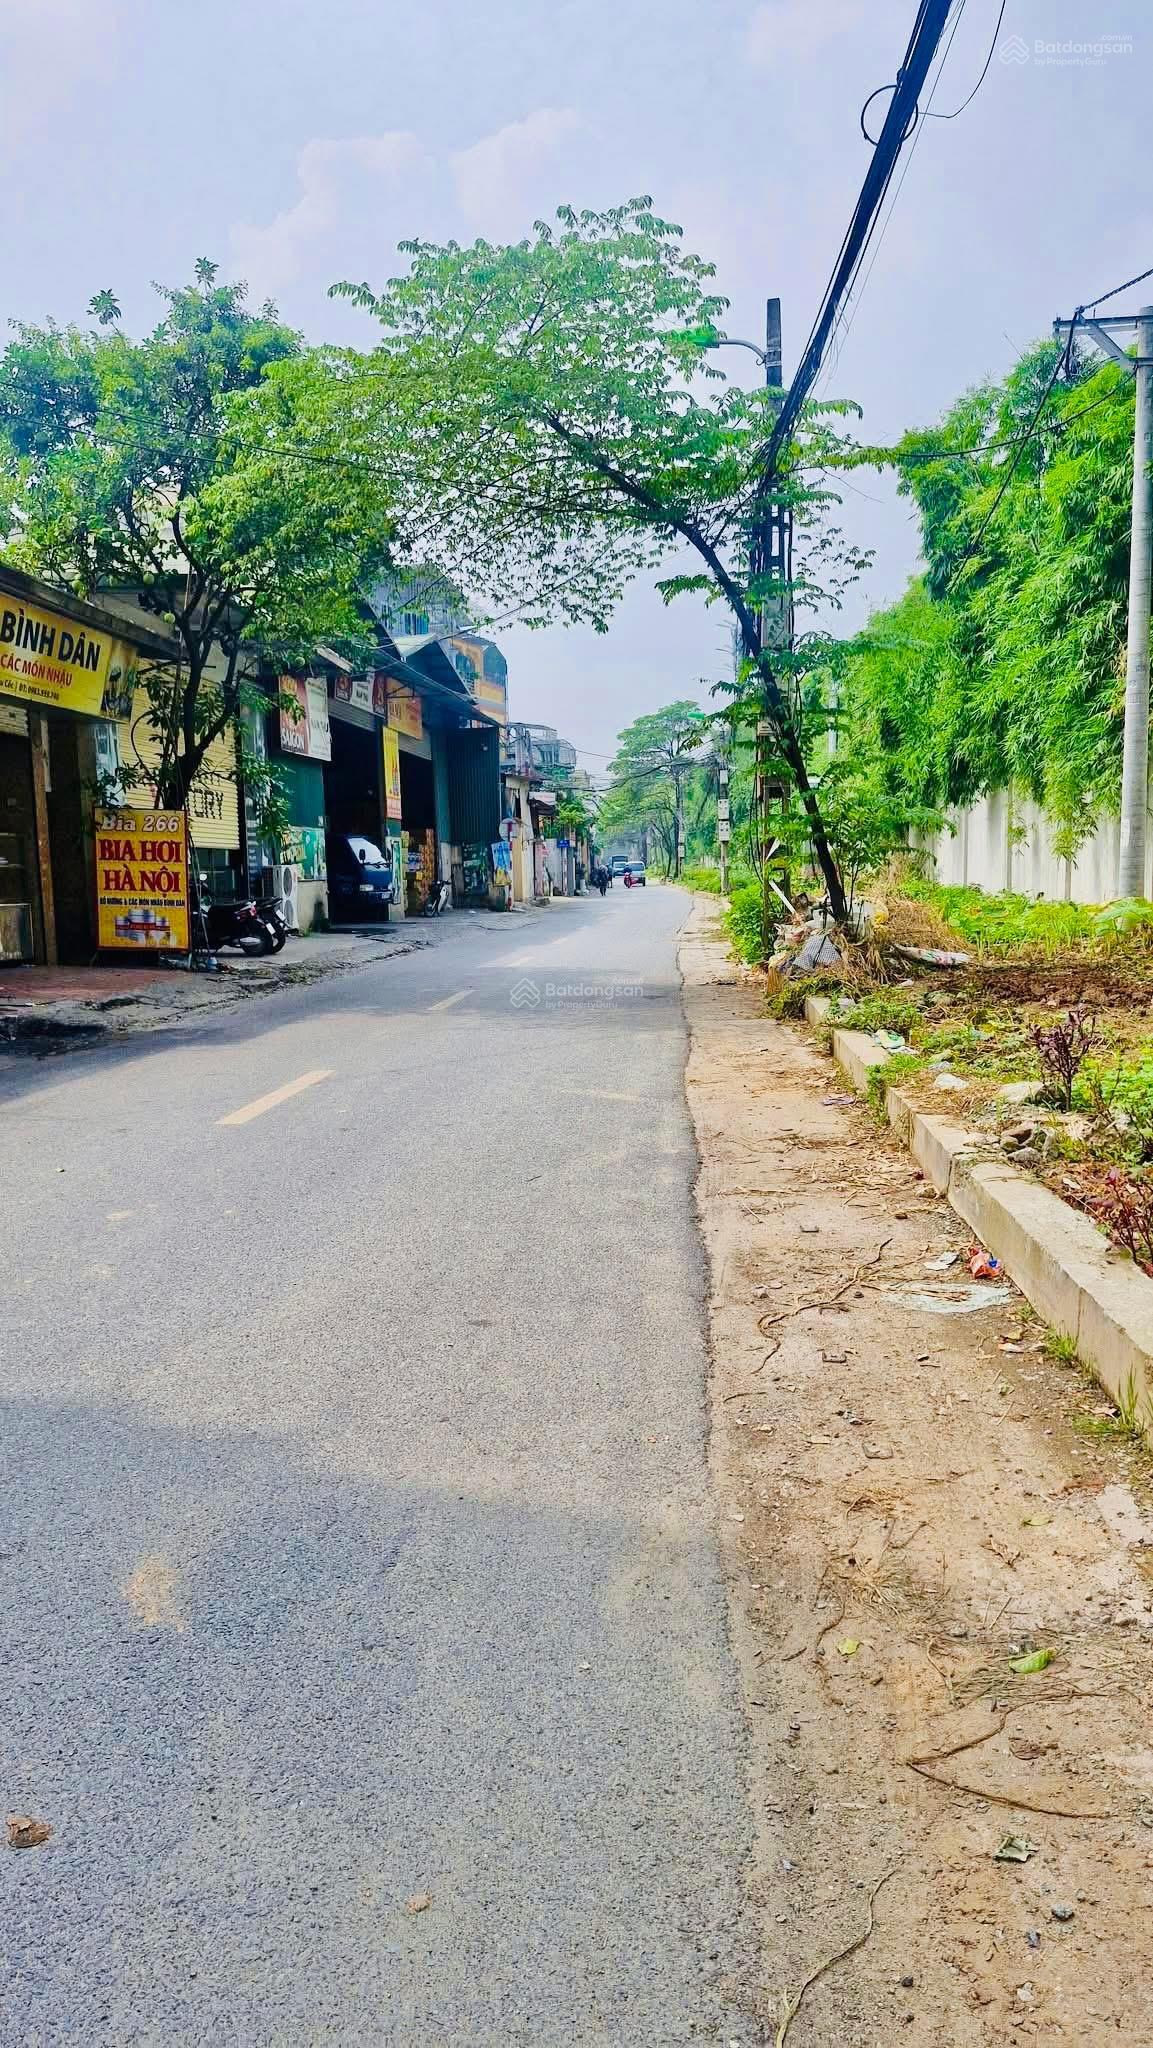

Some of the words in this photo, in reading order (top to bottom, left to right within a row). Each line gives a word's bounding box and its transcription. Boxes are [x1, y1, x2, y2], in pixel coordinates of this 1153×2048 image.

[0, 608, 56, 657] BÌNH
[58, 632, 101, 672] DÂN
[1, 653, 21, 672] CÁC
[22, 660, 46, 679] MÓN
[47, 668, 73, 688] NHẬU
[101, 813, 136, 832] Bia
[142, 815, 179, 832] 266
[99, 839, 137, 862] BIA
[139, 840, 182, 863] HƠI
[104, 863, 137, 892] HÀ
[139, 865, 181, 898] NỘI
